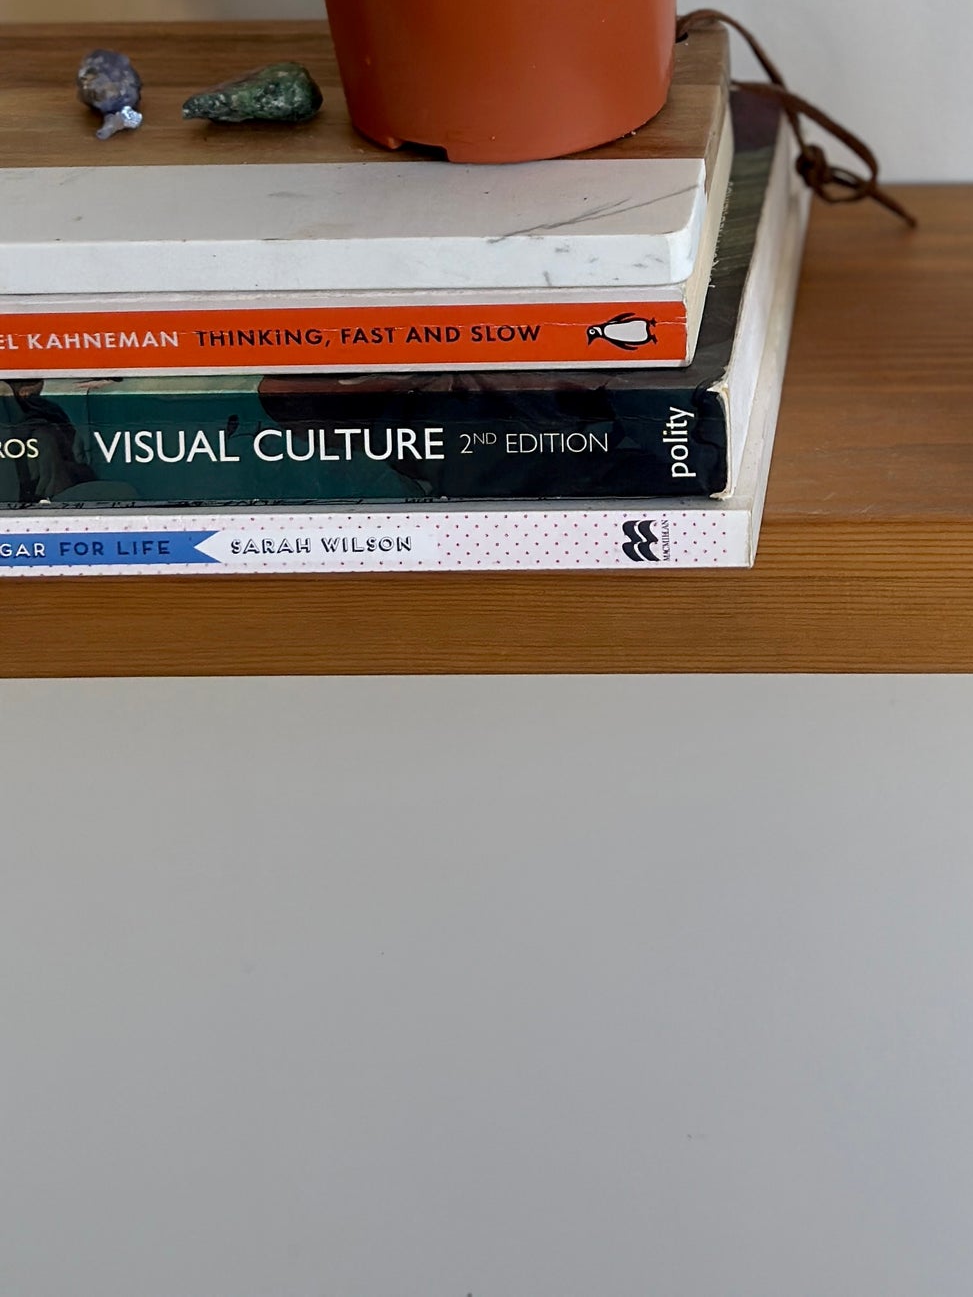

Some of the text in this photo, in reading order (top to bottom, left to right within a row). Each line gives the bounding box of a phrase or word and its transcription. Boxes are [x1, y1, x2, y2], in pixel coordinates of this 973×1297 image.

[27, 331, 179, 349] KAHNEMAN
[198, 324, 541, 347] THINKING, FAST AND SLOW
[94, 430, 240, 463] VISUAL
[253, 428, 445, 462] CULTURE
[505, 432, 608, 453] EDITION
[662, 406, 697, 478] polity
[59, 541, 104, 556] FOR
[117, 539, 171, 555] LIFE
[231, 535, 412, 555] SARAH WILSON
